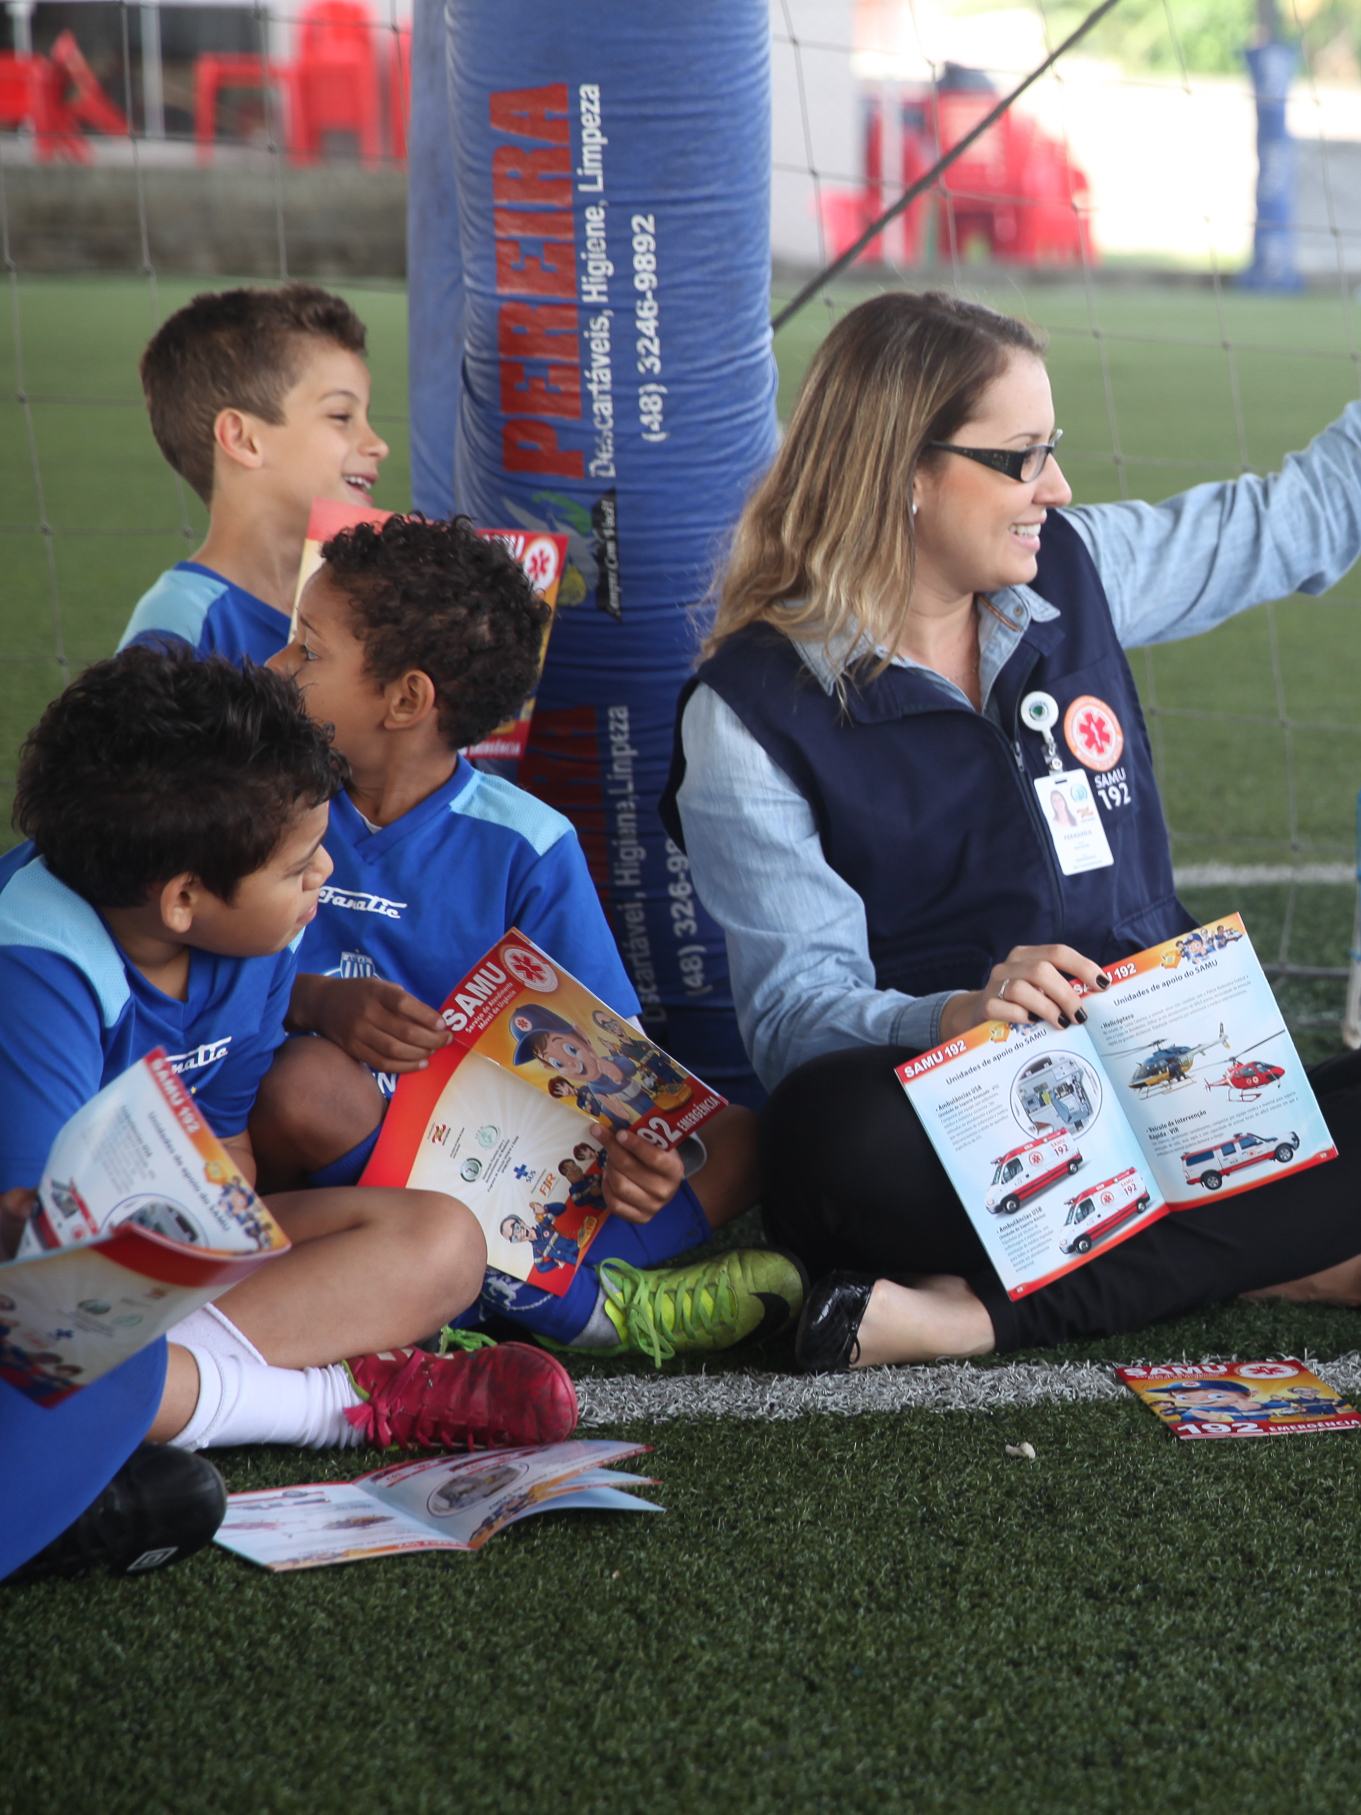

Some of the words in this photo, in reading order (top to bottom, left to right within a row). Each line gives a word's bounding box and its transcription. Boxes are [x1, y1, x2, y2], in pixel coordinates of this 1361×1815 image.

[576, 84, 609, 192] Limpeza
[581, 199, 615, 303] Higiene,
[489, 83, 585, 479] PEREIRA
[631, 213, 662, 375] 3246-9892
[638, 383, 671, 442] (48)
[1094, 767, 1127, 790] SAMU
[1097, 783, 1132, 811] 192
[1113, 986, 1151, 1007] Unidades
[1150, 981, 1161, 992] de
[1161, 973, 1184, 990] apoio
[1184, 968, 1195, 979] do
[1194, 959, 1218, 975] SAMU
[1114, 962, 1137, 980] 192
[442, 961, 507, 1032] SAMU
[165, 1036, 233, 1075] natic
[903, 1050, 945, 1080] SAMU
[944, 1039, 968, 1059] 192
[945, 1063, 982, 1086] Unidades
[981, 1057, 992, 1068] de
[992, 1046, 1014, 1064] apoio
[1013, 1041, 1025, 1051] do
[1024, 1028, 1048, 1046] SAMU
[637, 1116, 683, 1150] 92
[676, 1095, 721, 1132] EMERGÊNCIA
[1053, 1143, 1070, 1157] 192
[1123, 1183, 1138, 1196] 192
[1123, 1365, 1228, 1377] SAMU
[1177, 1422, 1264, 1435] 192
[1268, 1418, 1361, 1432] EMERGÊNCIA
